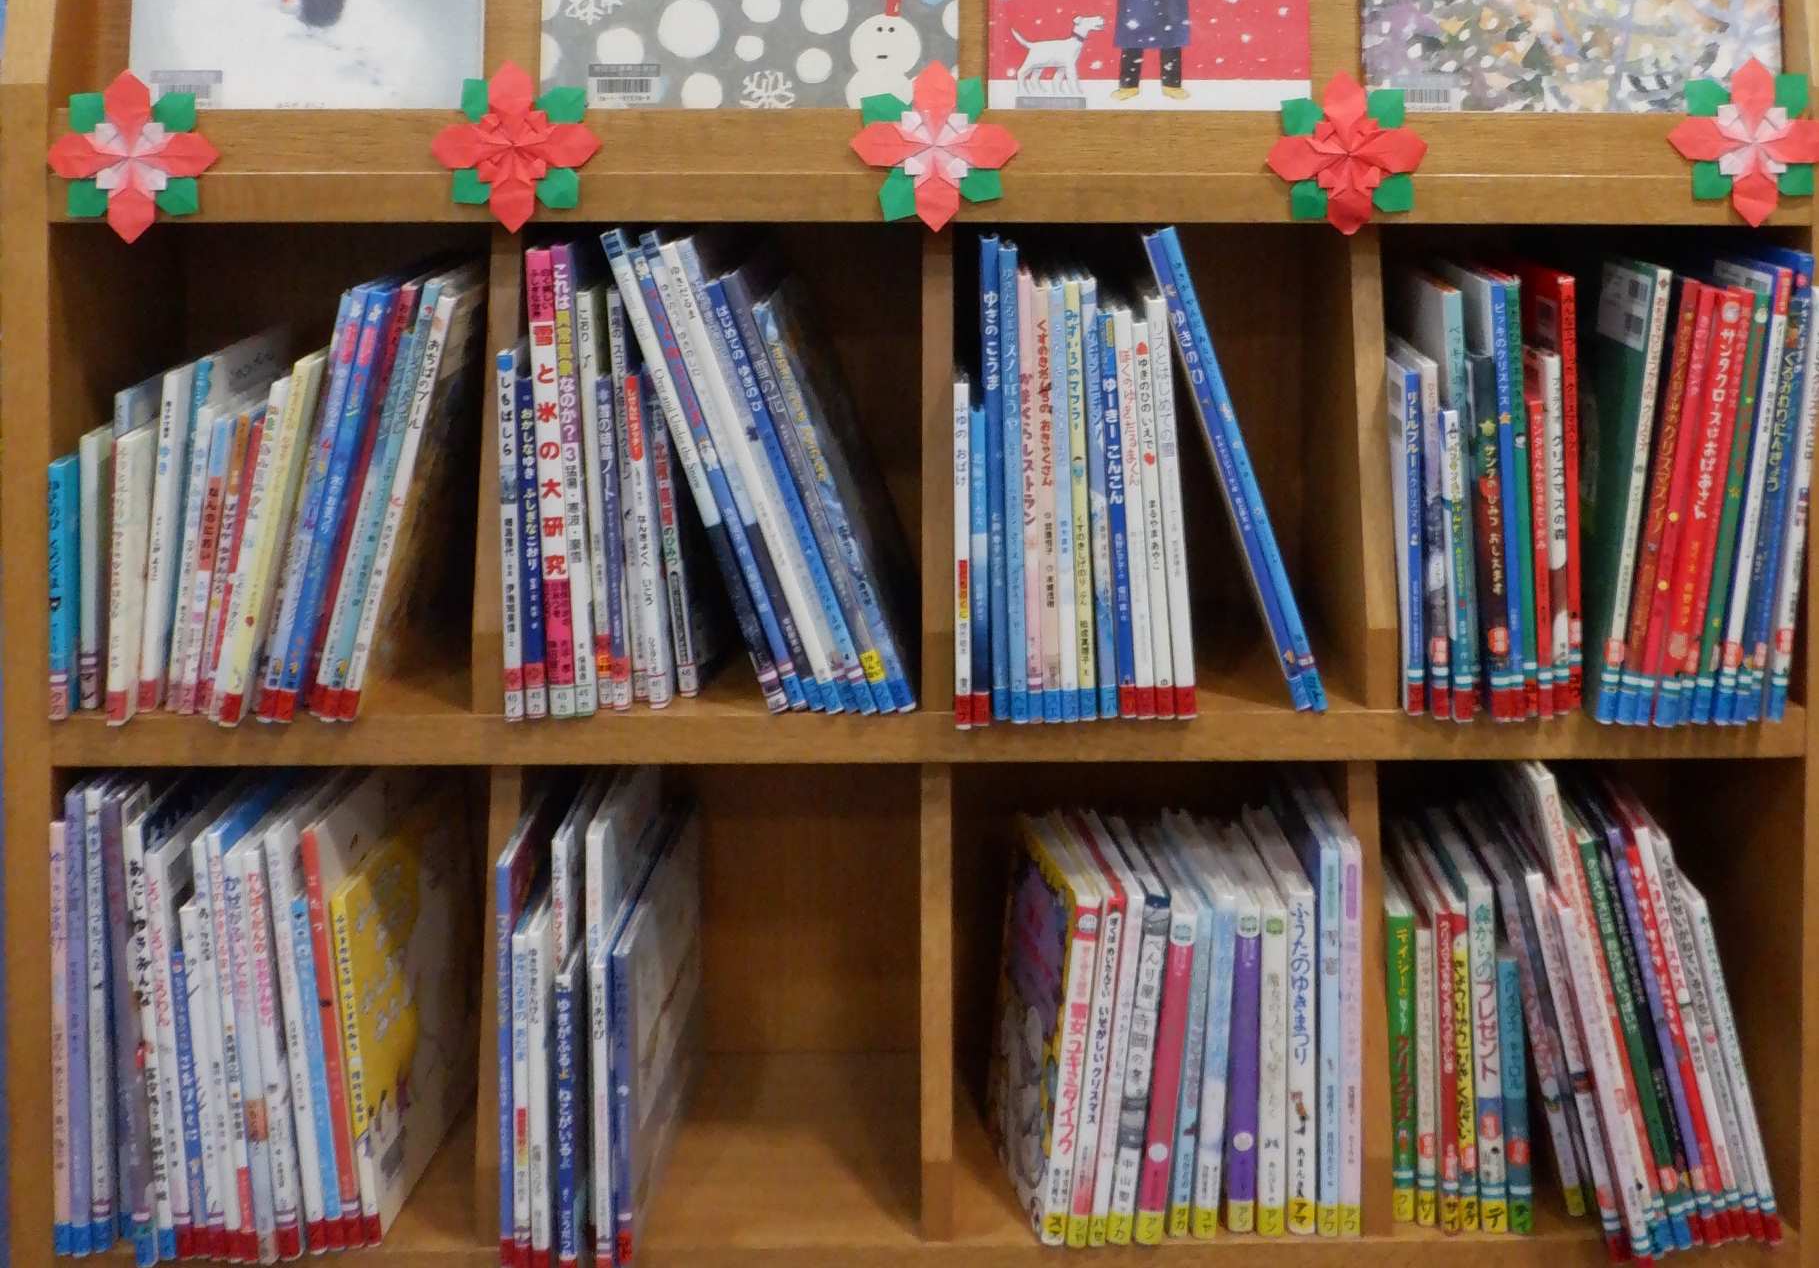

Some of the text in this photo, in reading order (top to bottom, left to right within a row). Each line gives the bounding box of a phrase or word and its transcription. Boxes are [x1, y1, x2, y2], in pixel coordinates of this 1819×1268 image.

[1064, 308, 1081, 431] みずいろのマフラー
[1171, 308, 1205, 385] ゆきのひ
[500, 376, 513, 457] しもばしら
[532, 325, 567, 576] 雪と氷の大研究
[1105, 444, 1124, 505] こんこん
[1289, 902, 1311, 1066] ふうたのゆきまつり
